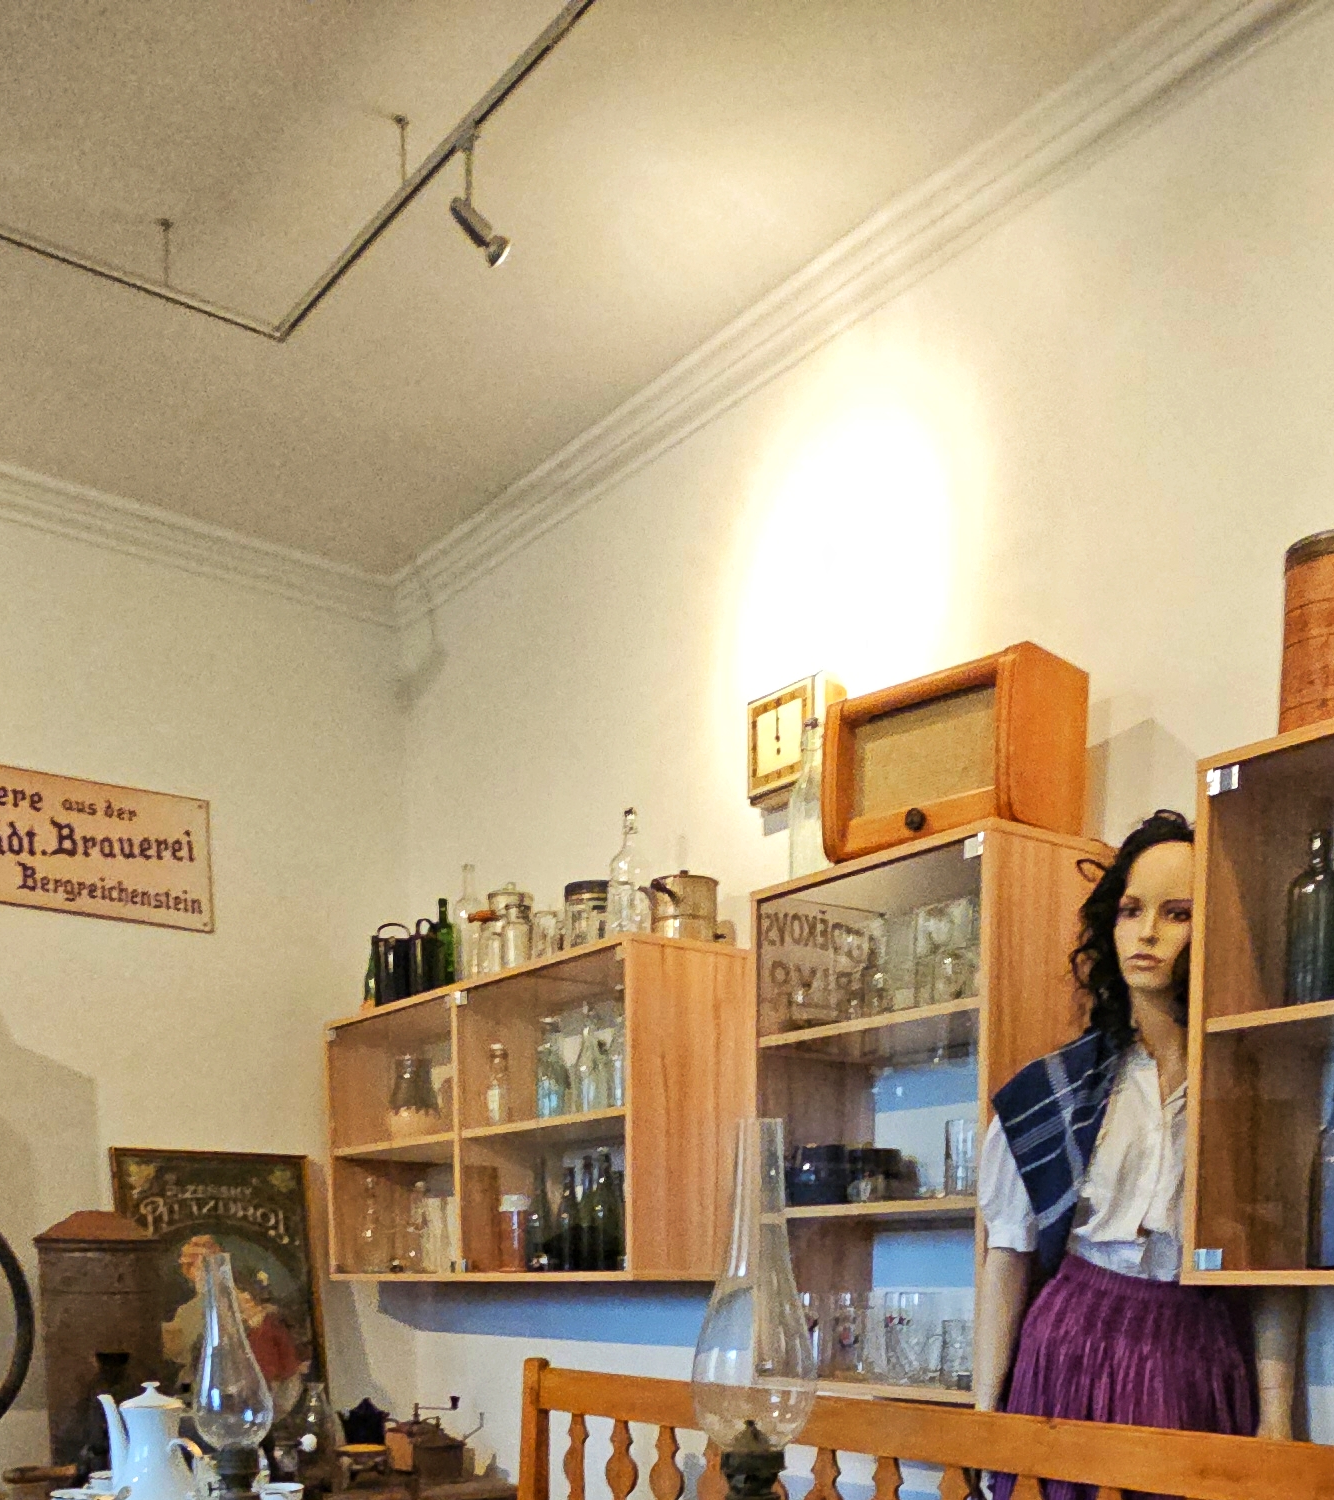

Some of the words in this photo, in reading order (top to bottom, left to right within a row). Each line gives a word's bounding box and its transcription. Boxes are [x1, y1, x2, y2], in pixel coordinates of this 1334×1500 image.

[61, 797, 98, 816] aus
[104, 800, 138, 822] der
[49, 816, 195, 863] Brauerei
[15, 861, 204, 916] Bergreichenstein
